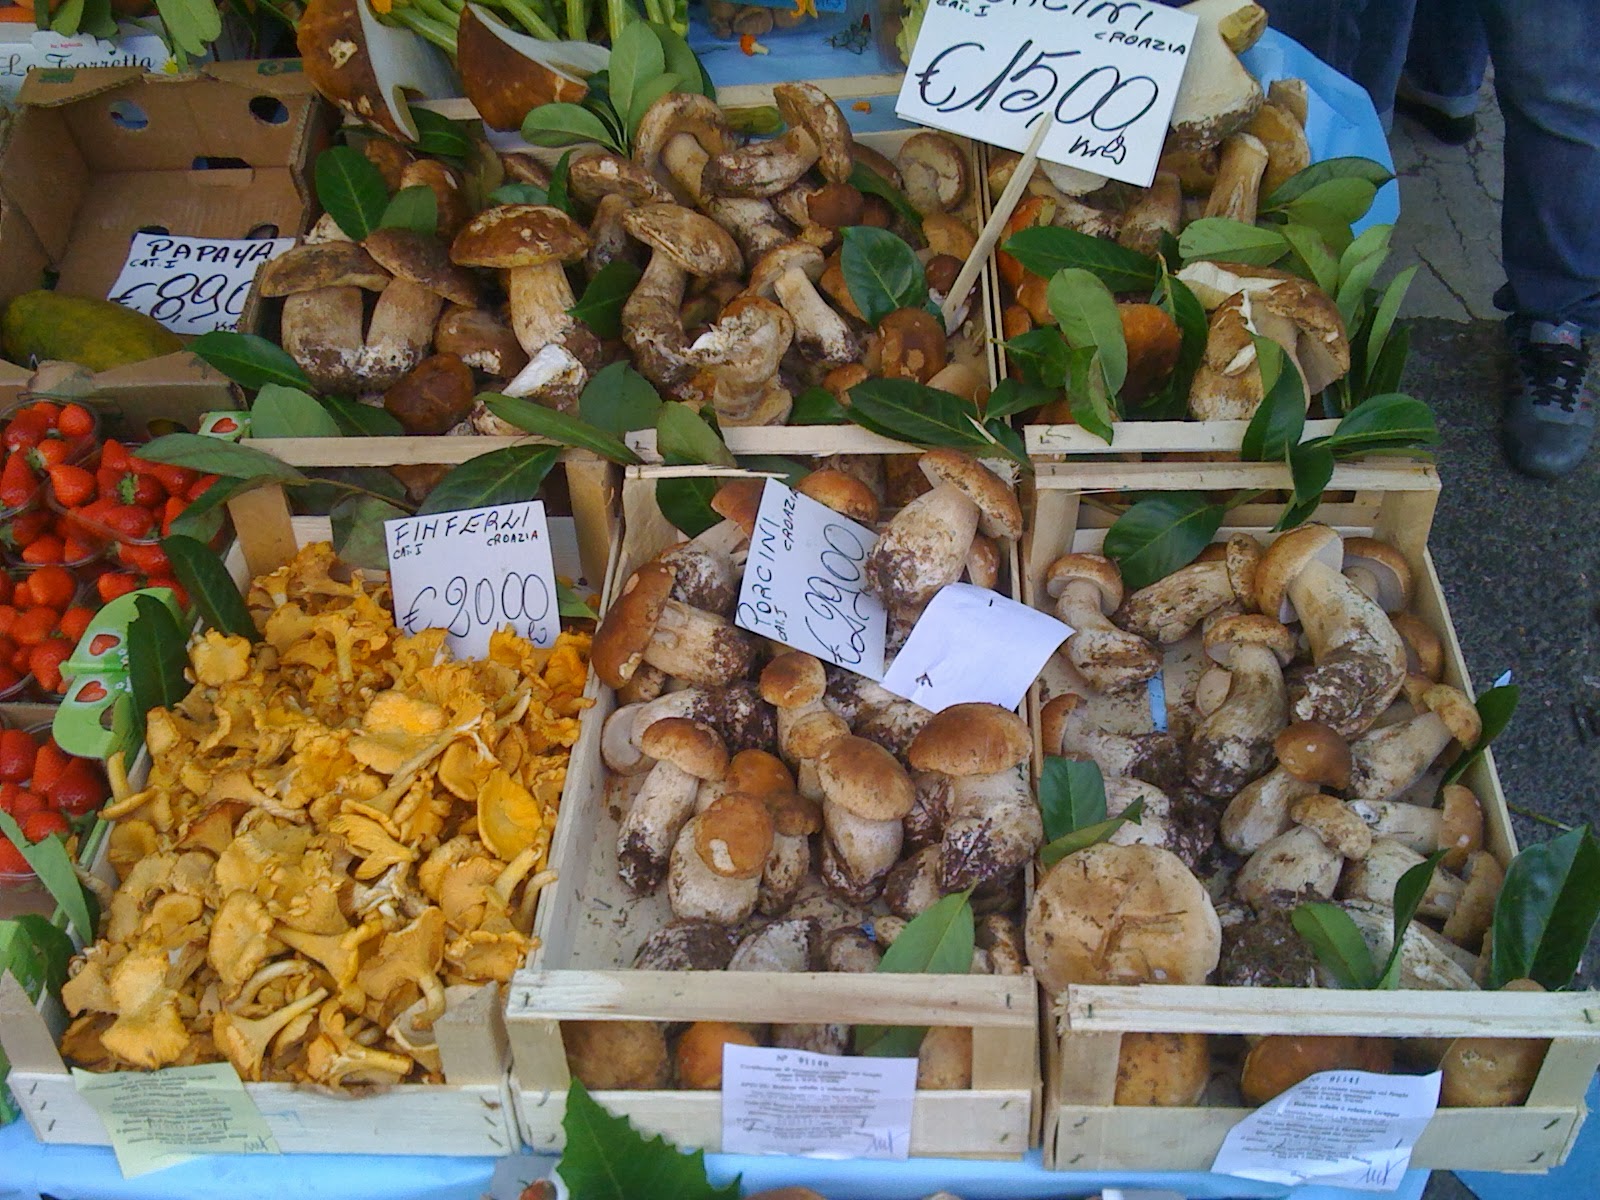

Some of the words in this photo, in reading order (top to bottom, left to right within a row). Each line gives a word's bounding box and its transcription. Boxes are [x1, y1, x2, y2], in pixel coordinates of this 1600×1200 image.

[1094, 31, 1187, 55] CROAZIA
[147, 238, 274, 268] PAPAYA
[487, 530, 539, 546] CROAZIA
[737, 518, 780, 635] PORCINI
